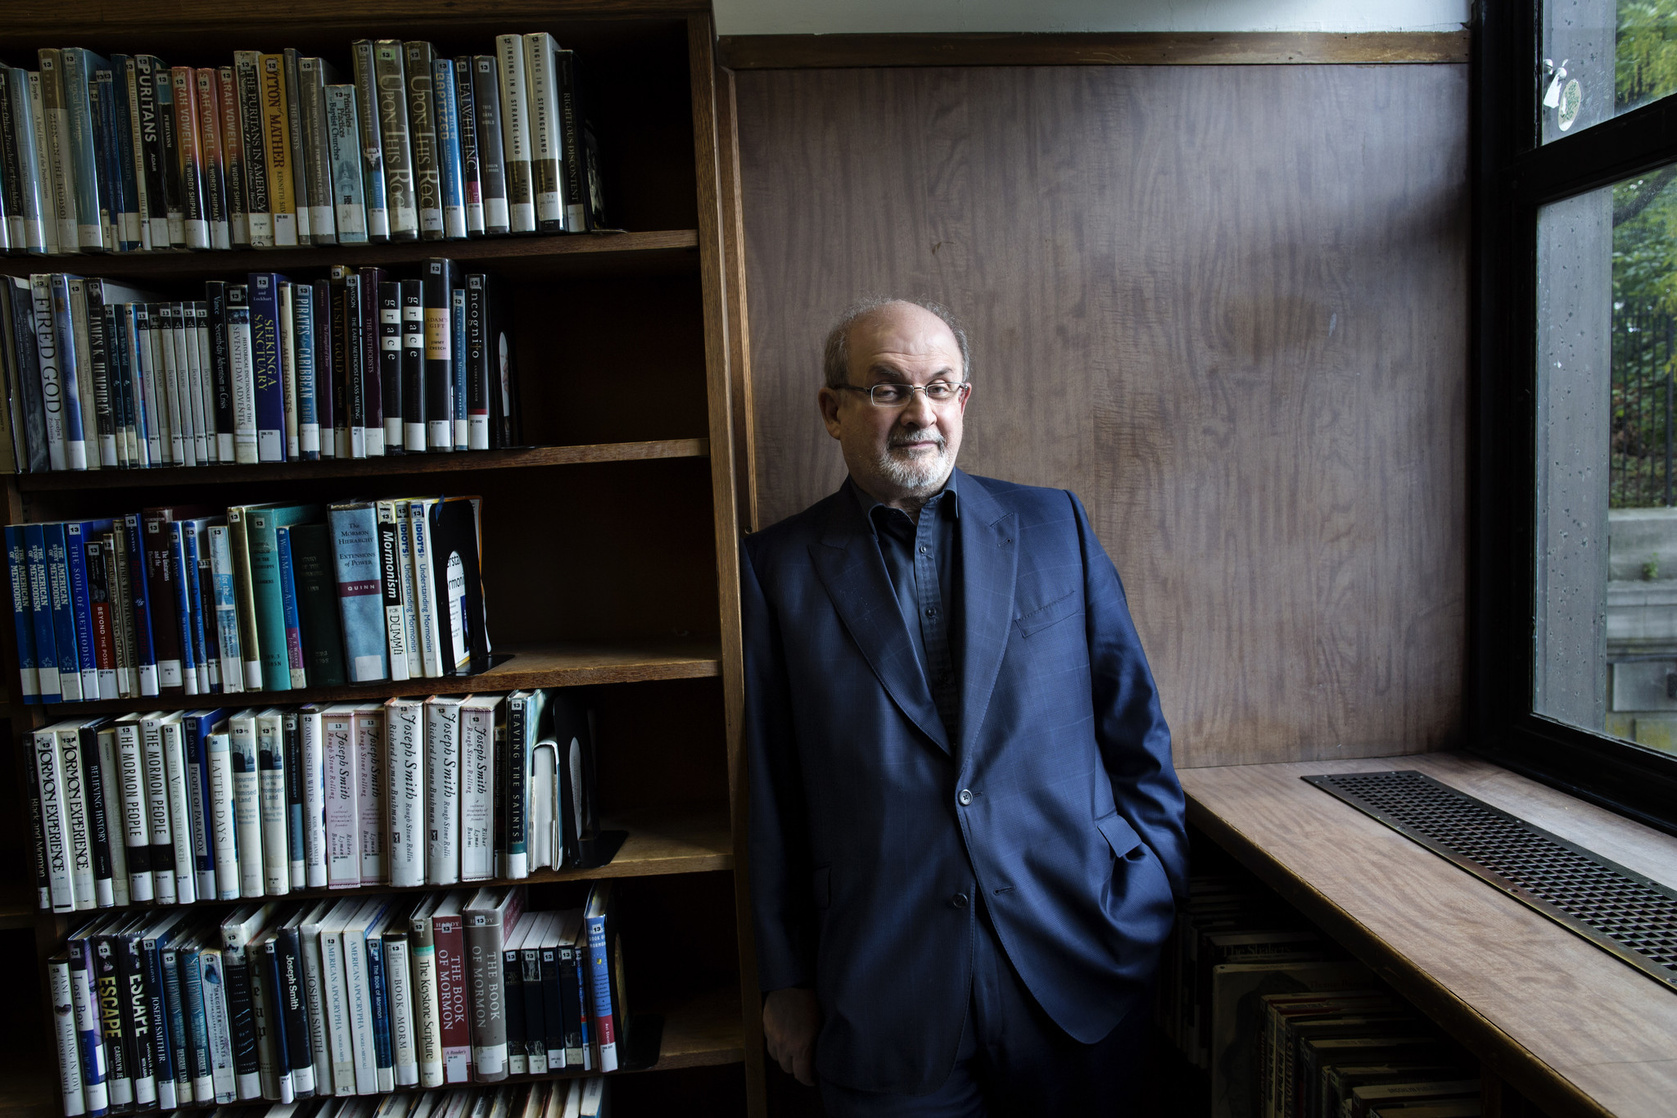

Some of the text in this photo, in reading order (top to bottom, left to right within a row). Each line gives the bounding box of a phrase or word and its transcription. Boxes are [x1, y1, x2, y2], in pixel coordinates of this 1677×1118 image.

[49, 113, 57, 138] ZION
[139, 65, 156, 142] PURITANS
[180, 109, 192, 149] VOWELL
[204, 111, 214, 151] VOWELL
[226, 109, 236, 149] VOWELL
[328, 102, 338, 126] Baptist
[344, 94, 352, 128] Principles
[361, 73, 373, 132] BOY'S FAITH
[381, 74, 406, 163] UPON THIS
[410, 76, 436, 164] UPON THIS
[436, 73, 449, 140] BAPTIZED
[459, 82, 474, 143] FALWELL
[246, 70, 266, 210] THE PURITANS IN AMERICA
[270, 114, 284, 168] MATHER
[563, 92, 578, 202] RIGHTEOUS DISCONTENT
[34, 296, 61, 413] FIRED GOD
[90, 314, 103, 346] JAMES
[92, 350, 104, 359] K.
[214, 323, 224, 354] Seventh-day
[232, 326, 242, 383] SEVENTH-DAY
[254, 314, 268, 391] SANCTUARY
[264, 319, 276, 374] SEEKING
[295, 299, 312, 398] PIRATES CARIBBEAN
[334, 296, 344, 373] WESLEY GOLD
[385, 299, 396, 360] grace
[407, 296, 418, 358] grace
[94, 363, 111, 416] HUMPHREY
[217, 356, 226, 384] Adventism
[283, 348, 292, 413] METHODISTS
[219, 393, 229, 409] Crisis
[383, 531, 398, 598] Mormonism
[416, 524, 424, 553] IDIOT'S
[10, 566, 22, 612] METHODISM
[19, 565, 29, 607] AMERICAN
[29, 564, 41, 612] METHODISM
[37, 564, 48, 606] AMERICAN
[50, 563, 61, 610] METHODISM
[57, 563, 68, 605] AMERICAN
[401, 524, 414, 613] IDIOT'S Understanding
[418, 564, 428, 613] Understanding
[78, 612, 90, 669] METHODISM
[136, 608, 147, 654] RIGHTEOUS
[336, 732, 349, 766] Joseph
[368, 730, 380, 798] Joseph Smith
[401, 714, 417, 800] Joseph Smith
[440, 714, 456, 798] Joseph Smith
[474, 727, 487, 760] Joseph
[90, 766, 106, 843] BELIEVING HISTORY
[123, 753, 141, 836] MORMON PEOPLE
[146, 729, 166, 834] THE MORMON PEOPLE
[212, 759, 226, 842] LATTER DAYS
[340, 769, 349, 800] Smith
[477, 763, 487, 794] Smith
[30, 798, 40, 820] Black
[35, 841, 45, 877] Mormon
[47, 804, 64, 872] EXPERIENCE
[70, 802, 88, 870] EXPERIENCE
[194, 810, 203, 852] PARADOX
[1248, 944, 1292, 954] Shakers
[73, 976, 83, 1000] Lost
[98, 976, 121, 1038] ESCAPE
[130, 974, 148, 1037] ESCAPE
[151, 996, 161, 1025] JOSEPH
[286, 955, 298, 1010] Joseph Smith
[331, 984, 341, 1030] APOCRYPHA
[350, 941, 364, 1029] AMERICAN APOCRYPHA
[419, 960, 435, 1059] The Keystone Scripture
[439, 950, 453, 1030] OF MORMON
[451, 956, 464, 1022] THE BOOK
[472, 946, 486, 1028] OF MORMON
[487, 952, 500, 1020] THE BOOK
[66, 1024, 75, 1058] FALLING
[155, 1027, 164, 1049] SMITH
[307, 973, 322, 1053] JOSEPH SMITH
[114, 1046, 122, 1072] CAROLYN
